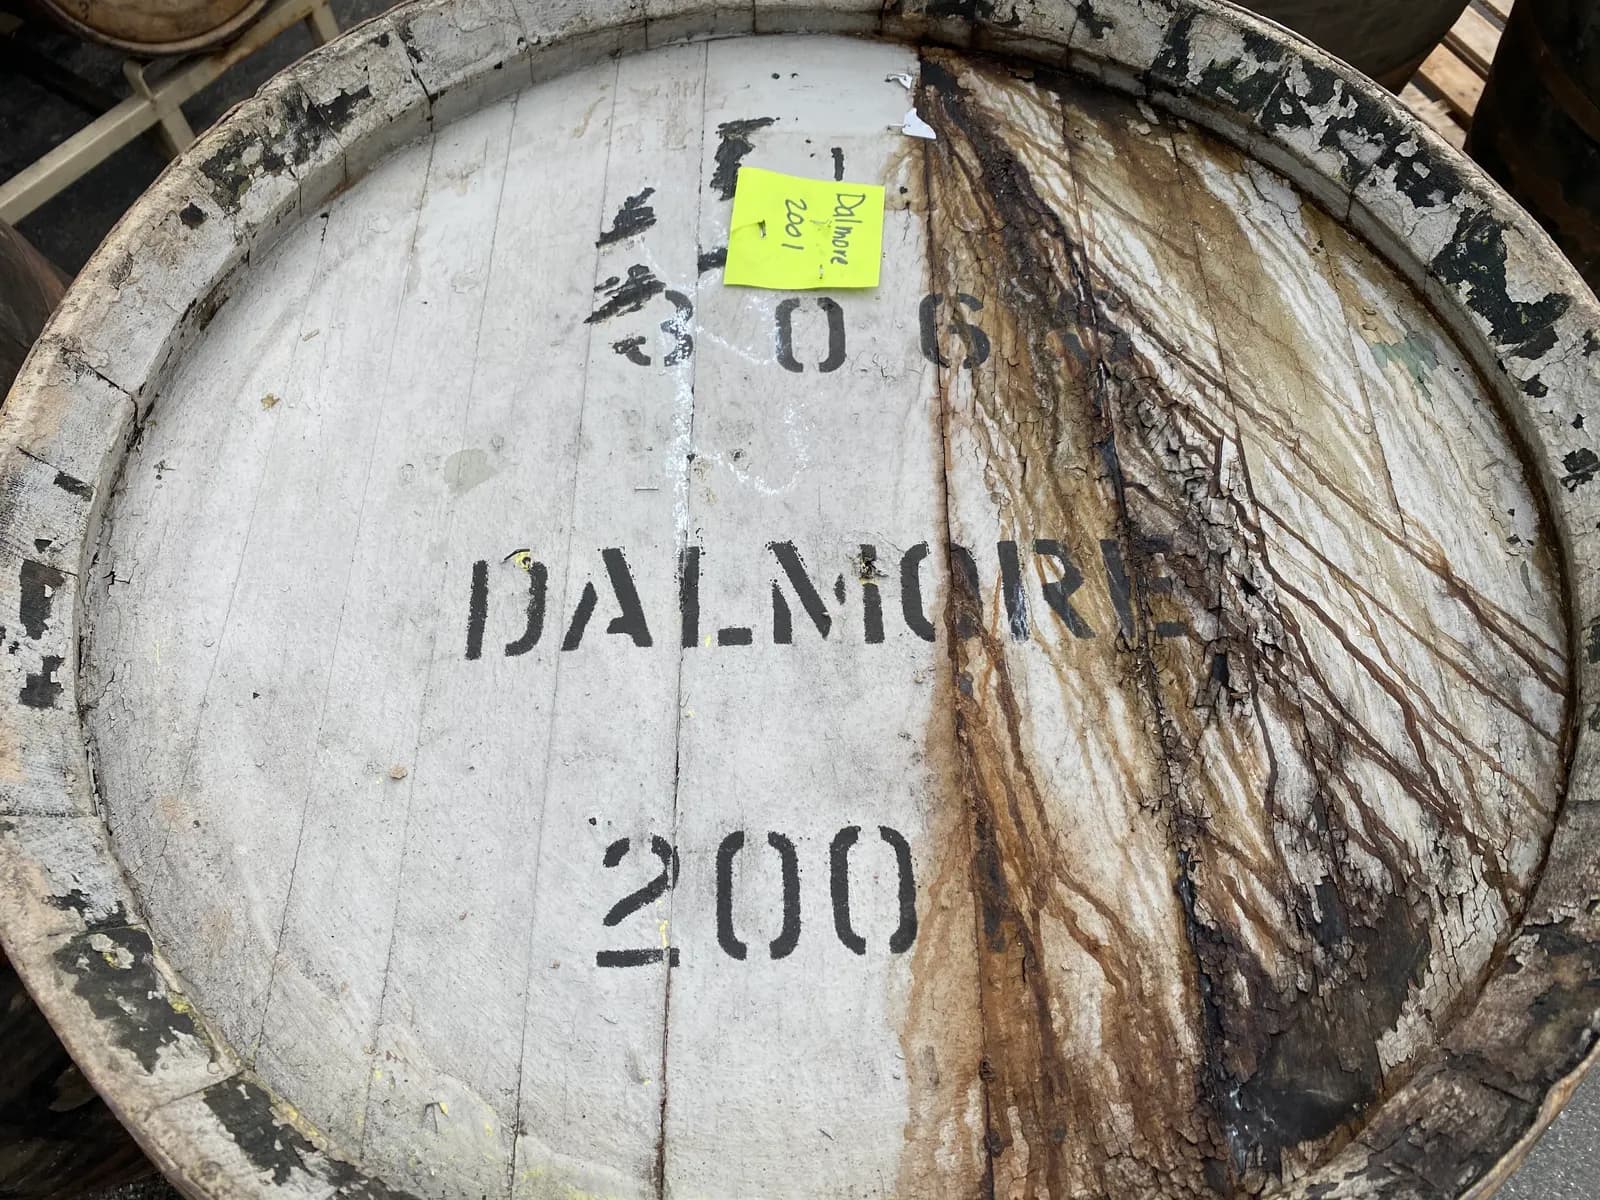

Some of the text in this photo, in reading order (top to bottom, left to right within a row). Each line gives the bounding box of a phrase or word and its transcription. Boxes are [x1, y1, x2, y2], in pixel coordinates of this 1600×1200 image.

[781, 198, 808, 251] 2001
[830, 192, 867, 266] Dalmore
[464, 540, 1188, 661] DALMORE
